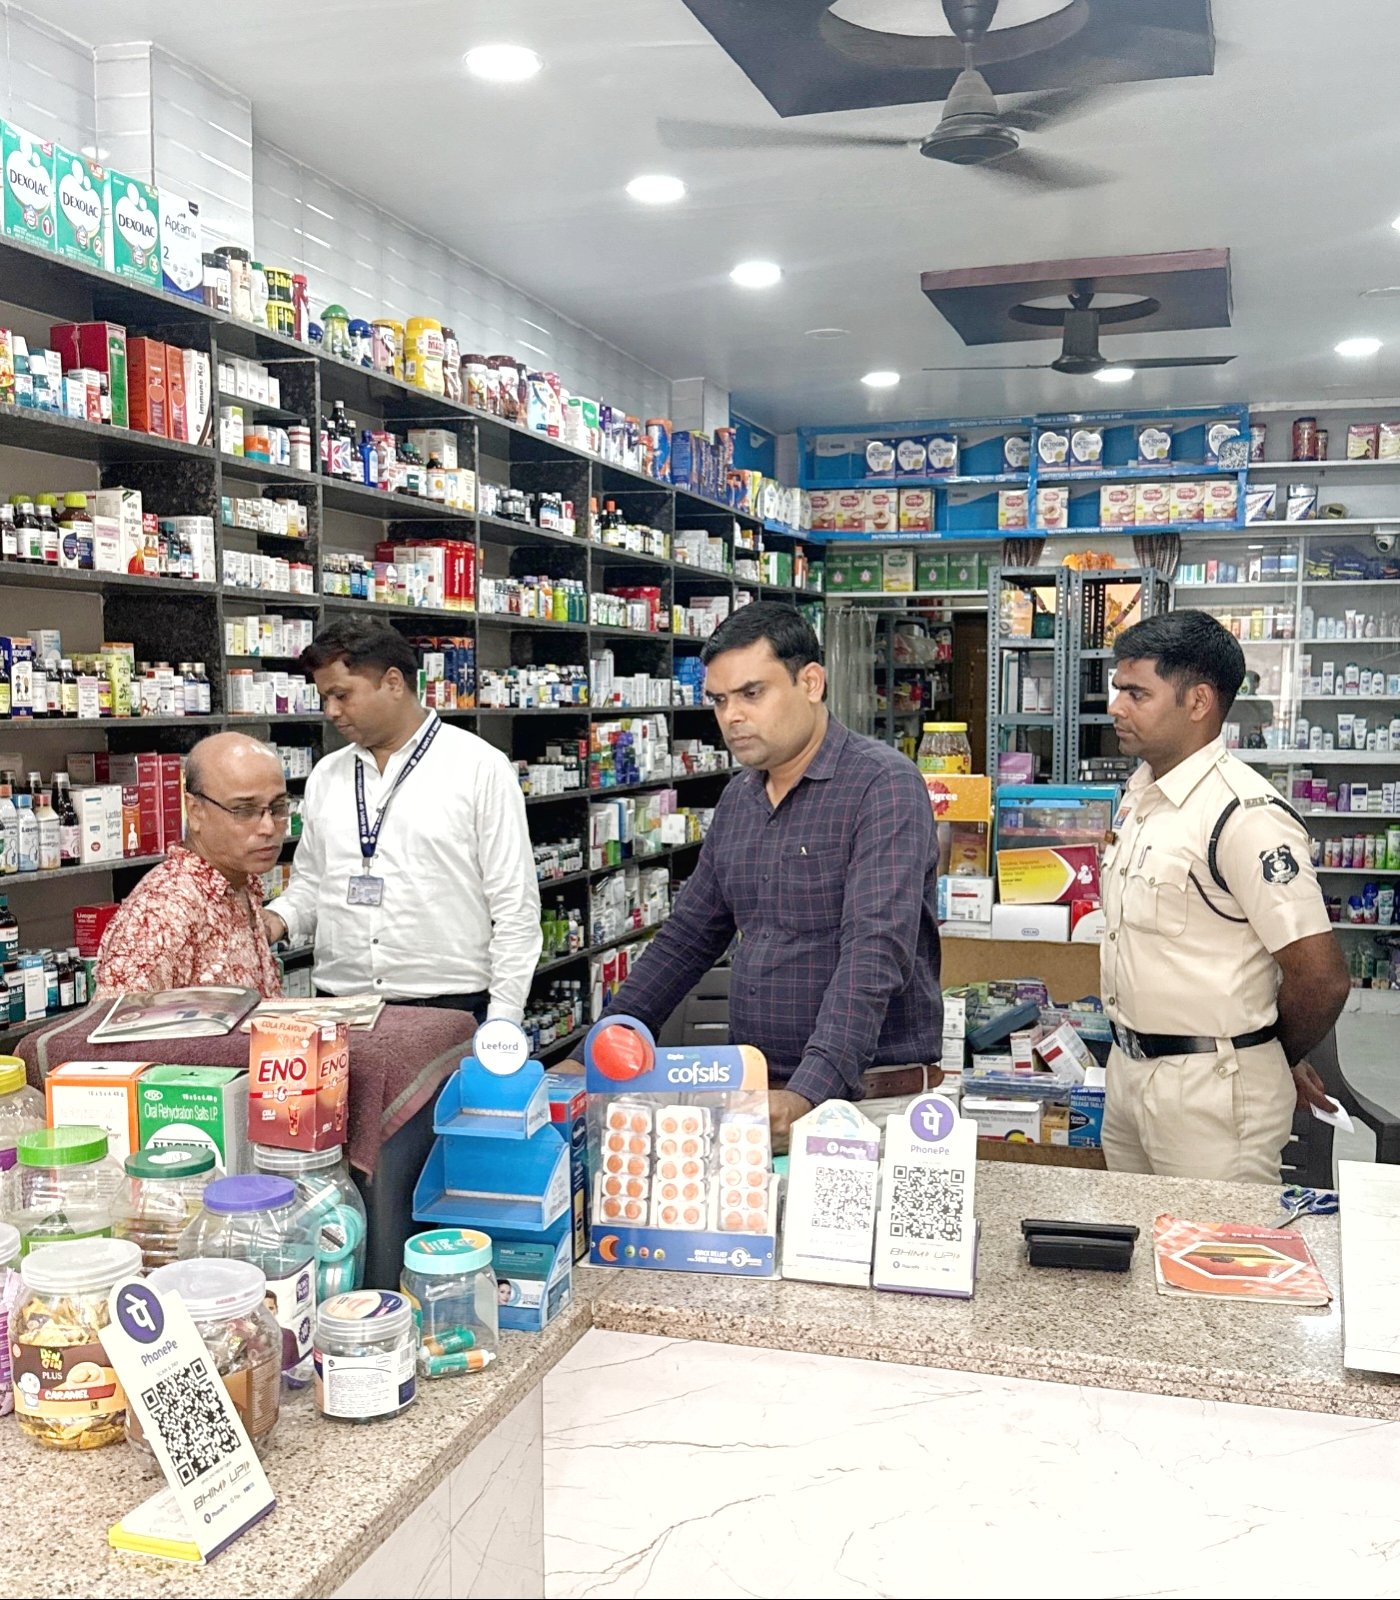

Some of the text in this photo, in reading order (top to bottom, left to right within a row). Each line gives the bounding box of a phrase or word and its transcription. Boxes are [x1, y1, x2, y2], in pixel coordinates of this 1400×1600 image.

[10, 168, 48, 197] DEXOLAC
[63, 191, 98, 218] DEXOLAC
[118, 213, 155, 238] DEXOLAC
[163, 246, 169, 259] 2
[261, 1021, 307, 1032] COLA FLAVOUR
[481, 1041, 519, 1051] Leeford
[258, 1057, 307, 1083] ENO
[320, 1053, 347, 1078] ENO
[668, 1061, 731, 1085] cofsils
[277, 1088, 286, 1101] 6
[144, 1104, 157, 1119] Oral
[158, 1104, 194, 1122] Rehydration
[194, 1107, 209, 1120] Salts
[921, 1103, 943, 1136] पे
[910, 1144, 950, 1156] PhonePe
[124, 1293, 156, 1331] पे
[140, 1340, 178, 1367] PhonePe
[42, 1371, 63, 1380] PLUS
[44, 1389, 89, 1400] CARAMEL
[194, 1480, 223, 1511] BHIM
